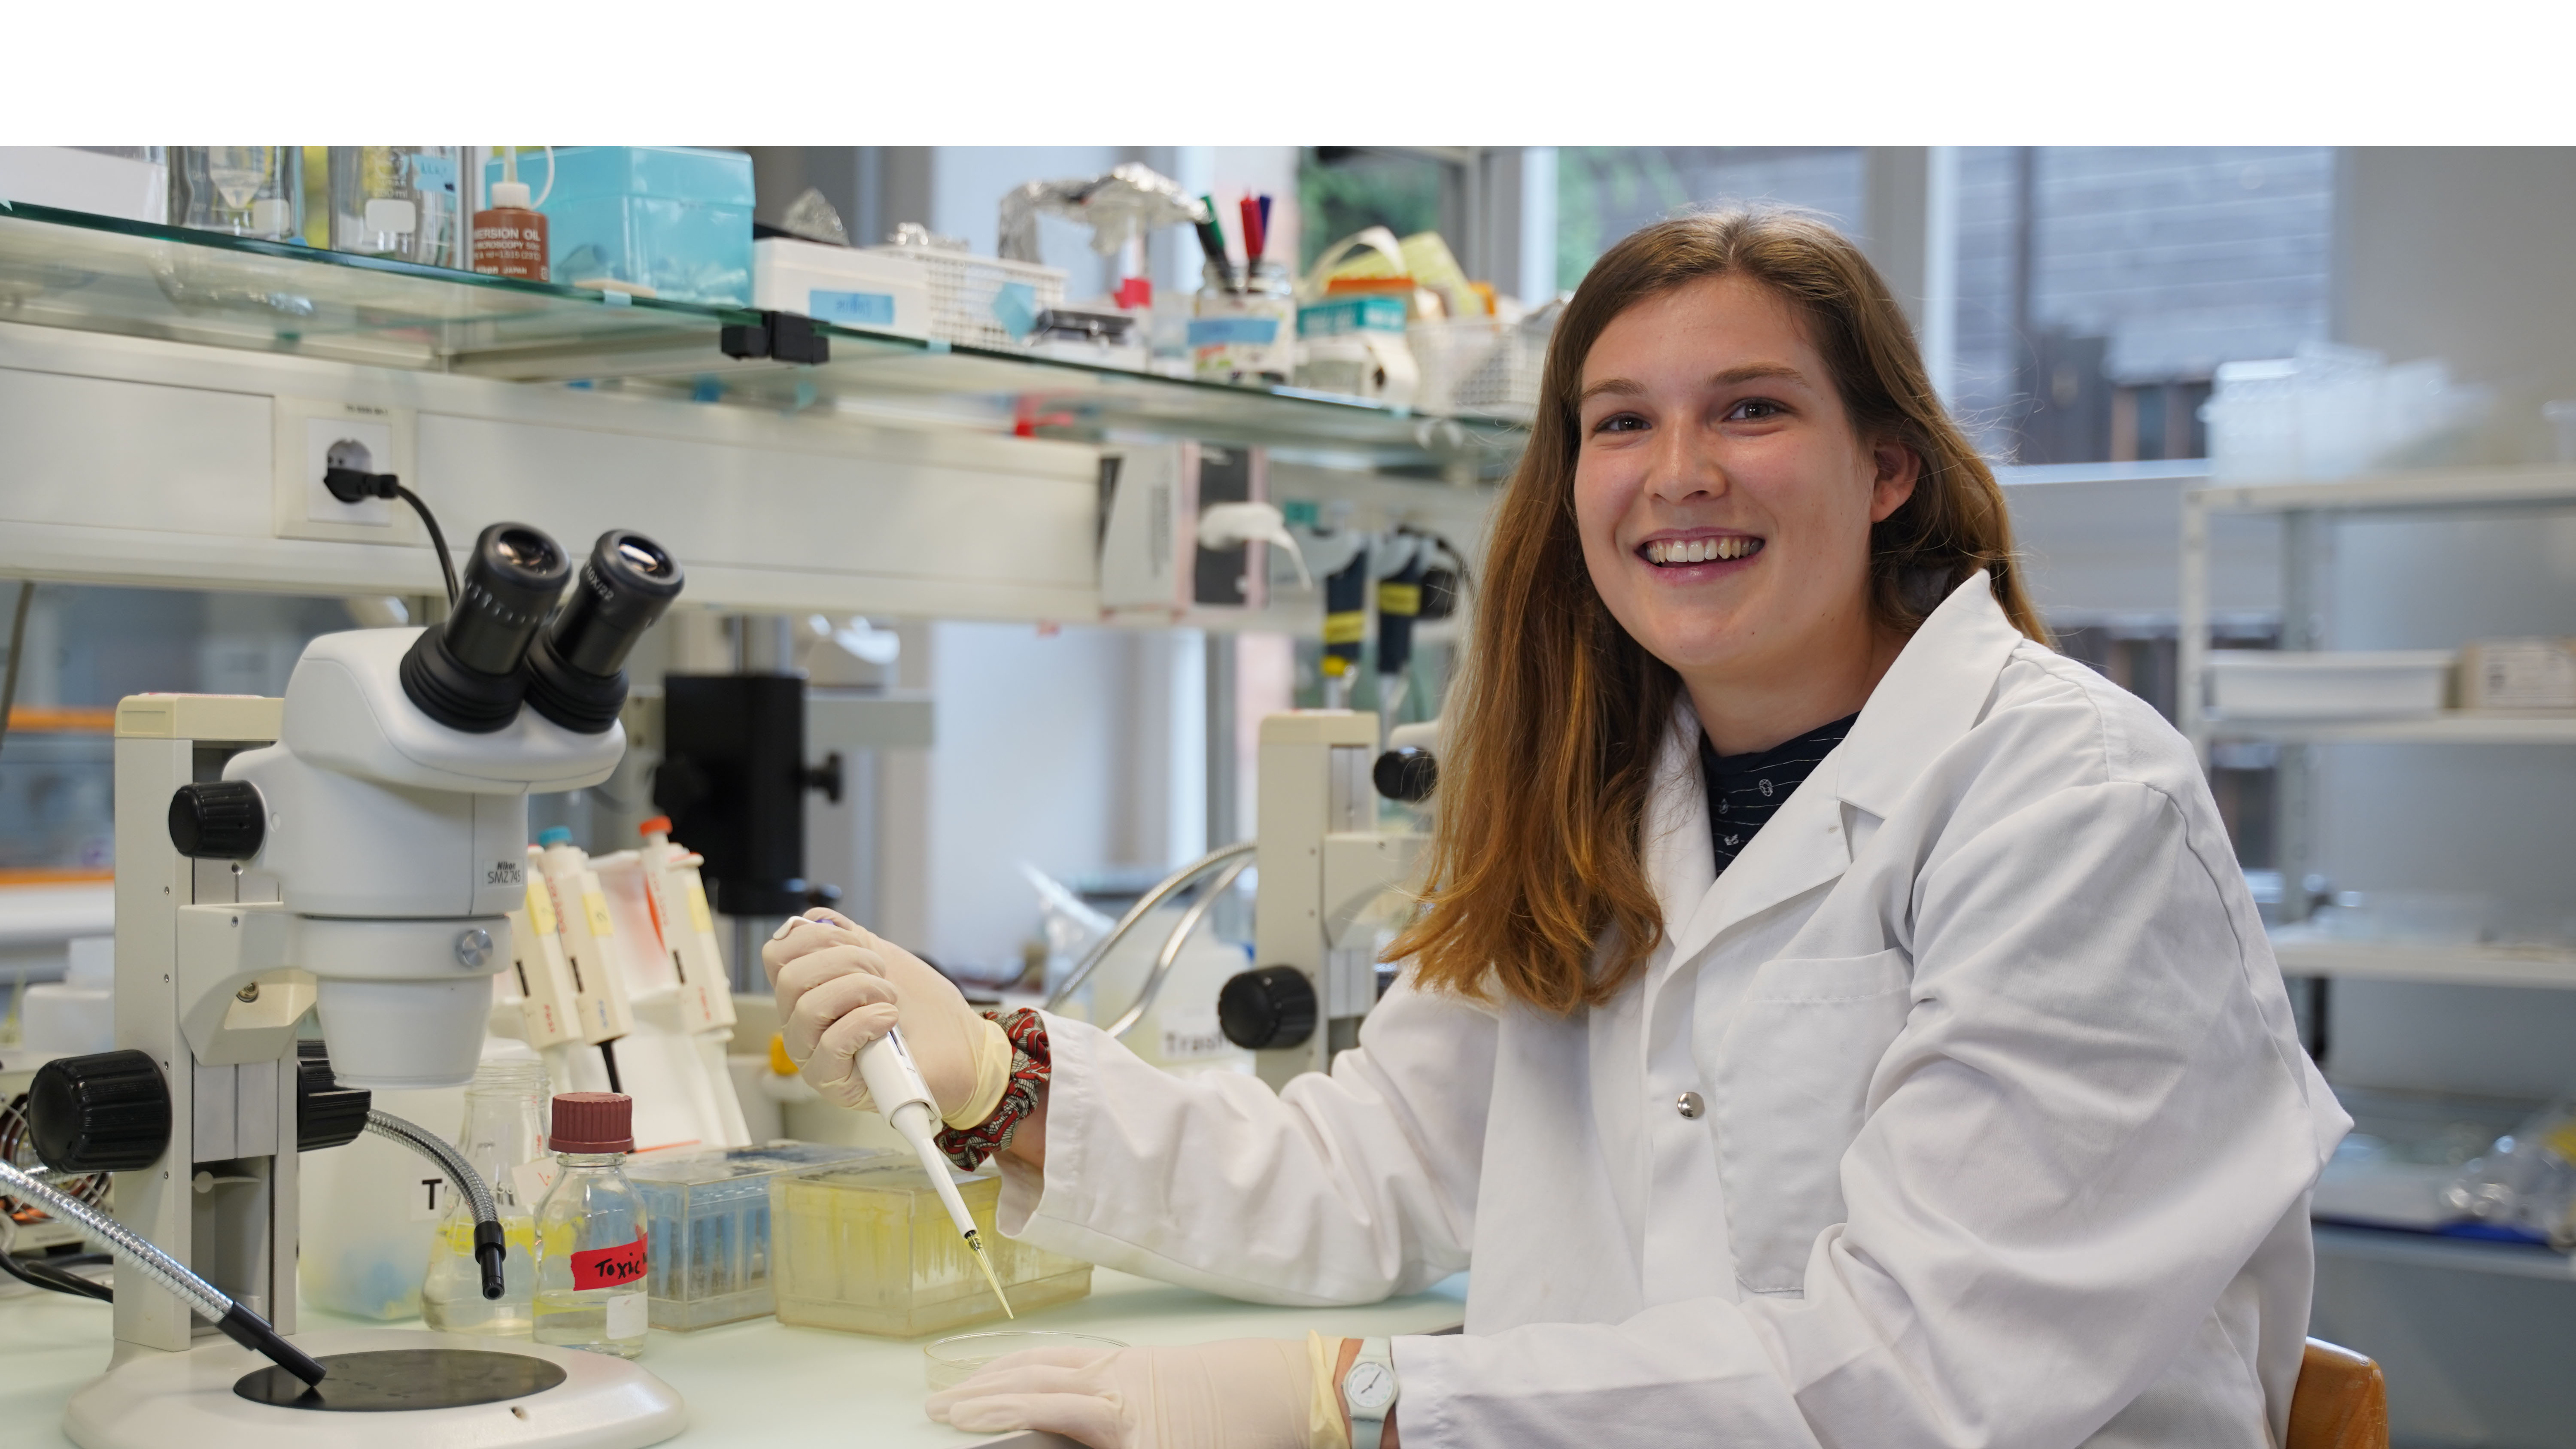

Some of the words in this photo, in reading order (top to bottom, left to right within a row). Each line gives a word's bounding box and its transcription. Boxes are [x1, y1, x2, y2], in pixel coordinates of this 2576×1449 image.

[522, 228, 541, 242] OIL
[497, 861, 516, 870] Nikon
[595, 1252, 641, 1279] Toxic
